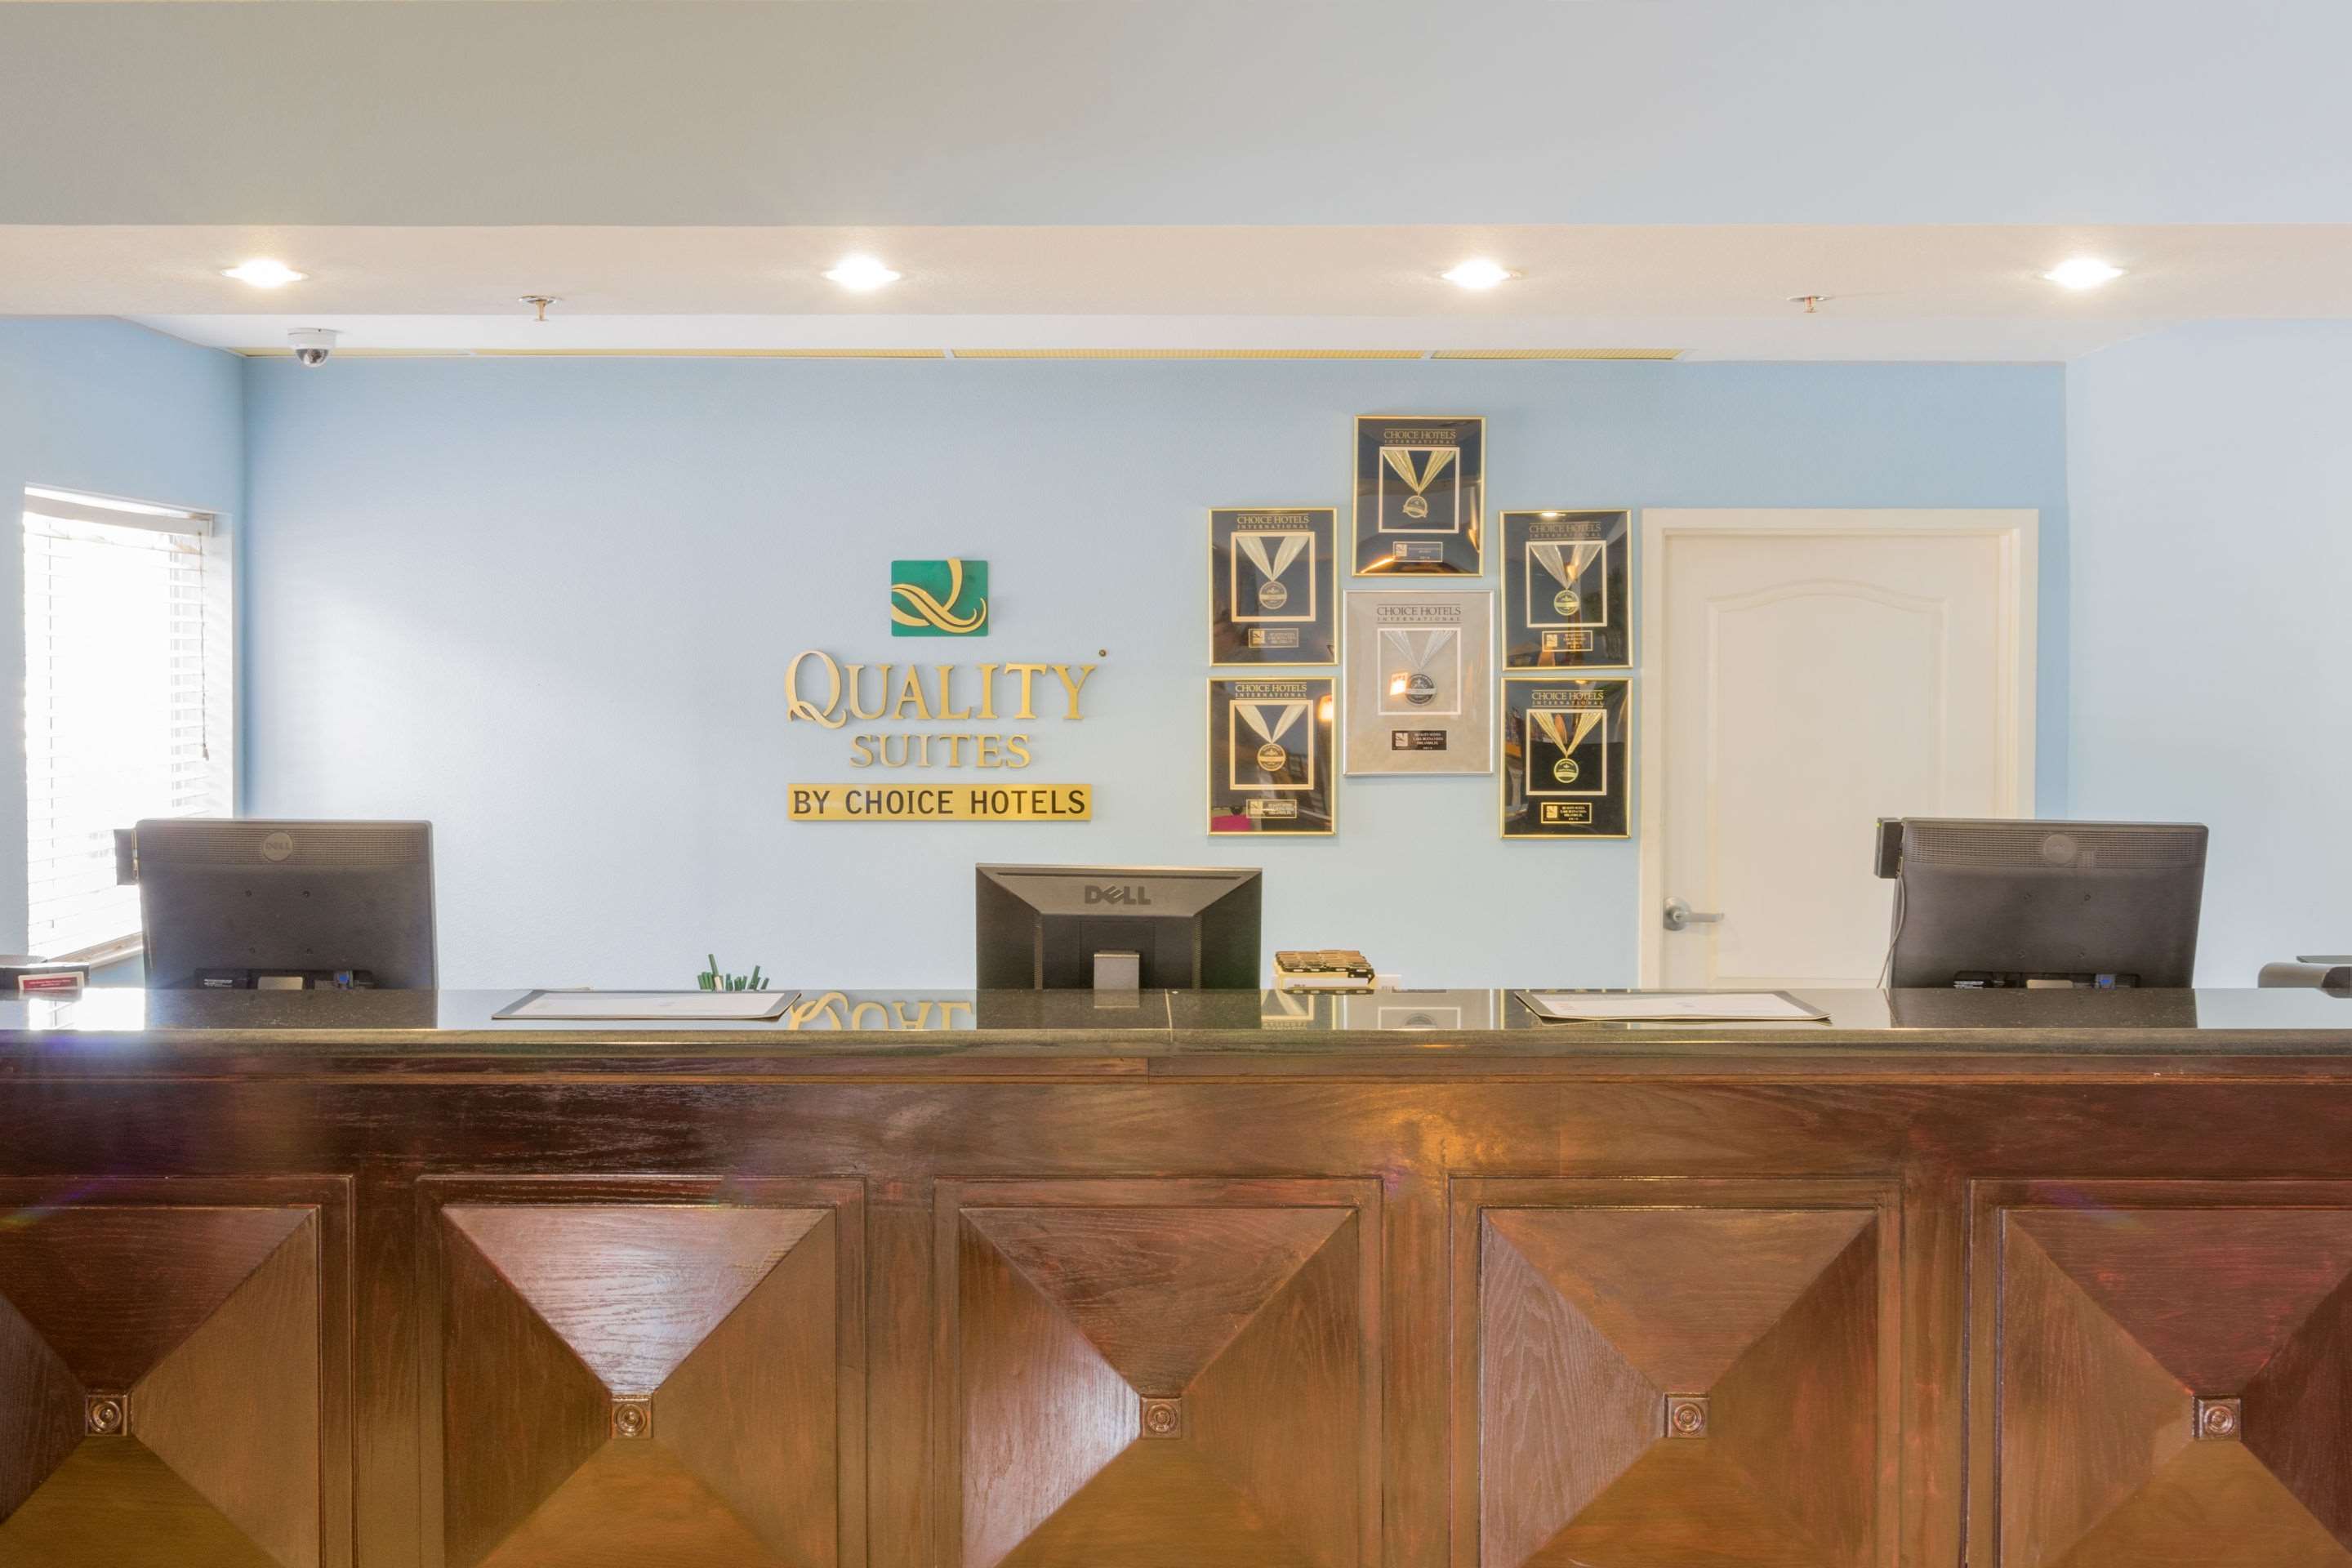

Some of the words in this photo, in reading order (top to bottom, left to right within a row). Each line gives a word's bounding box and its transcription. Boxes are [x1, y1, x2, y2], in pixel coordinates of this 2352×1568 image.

[1383, 430, 1419, 439] CHOICE
[1421, 430, 1457, 439] HOTELS
[1236, 515, 1272, 524] CHOICE
[1274, 515, 1310, 523] HOTELS
[1376, 606, 1419, 616] CHOICE
[1420, 606, 1462, 616] HOTELS
[784, 650, 1097, 729] QUALITY
[1235, 684, 1269, 693] CHOICE
[1272, 684, 1307, 693] HOTELS
[1531, 692, 1567, 701] CHOICE
[1569, 692, 1604, 701] HOTELS
[849, 733, 1032, 768] SUITES
[793, 790, 831, 815] BY
[845, 790, 954, 815] CHOICE
[971, 790, 1086, 815] HOTELS
[1085, 884, 1152, 906] DELL
